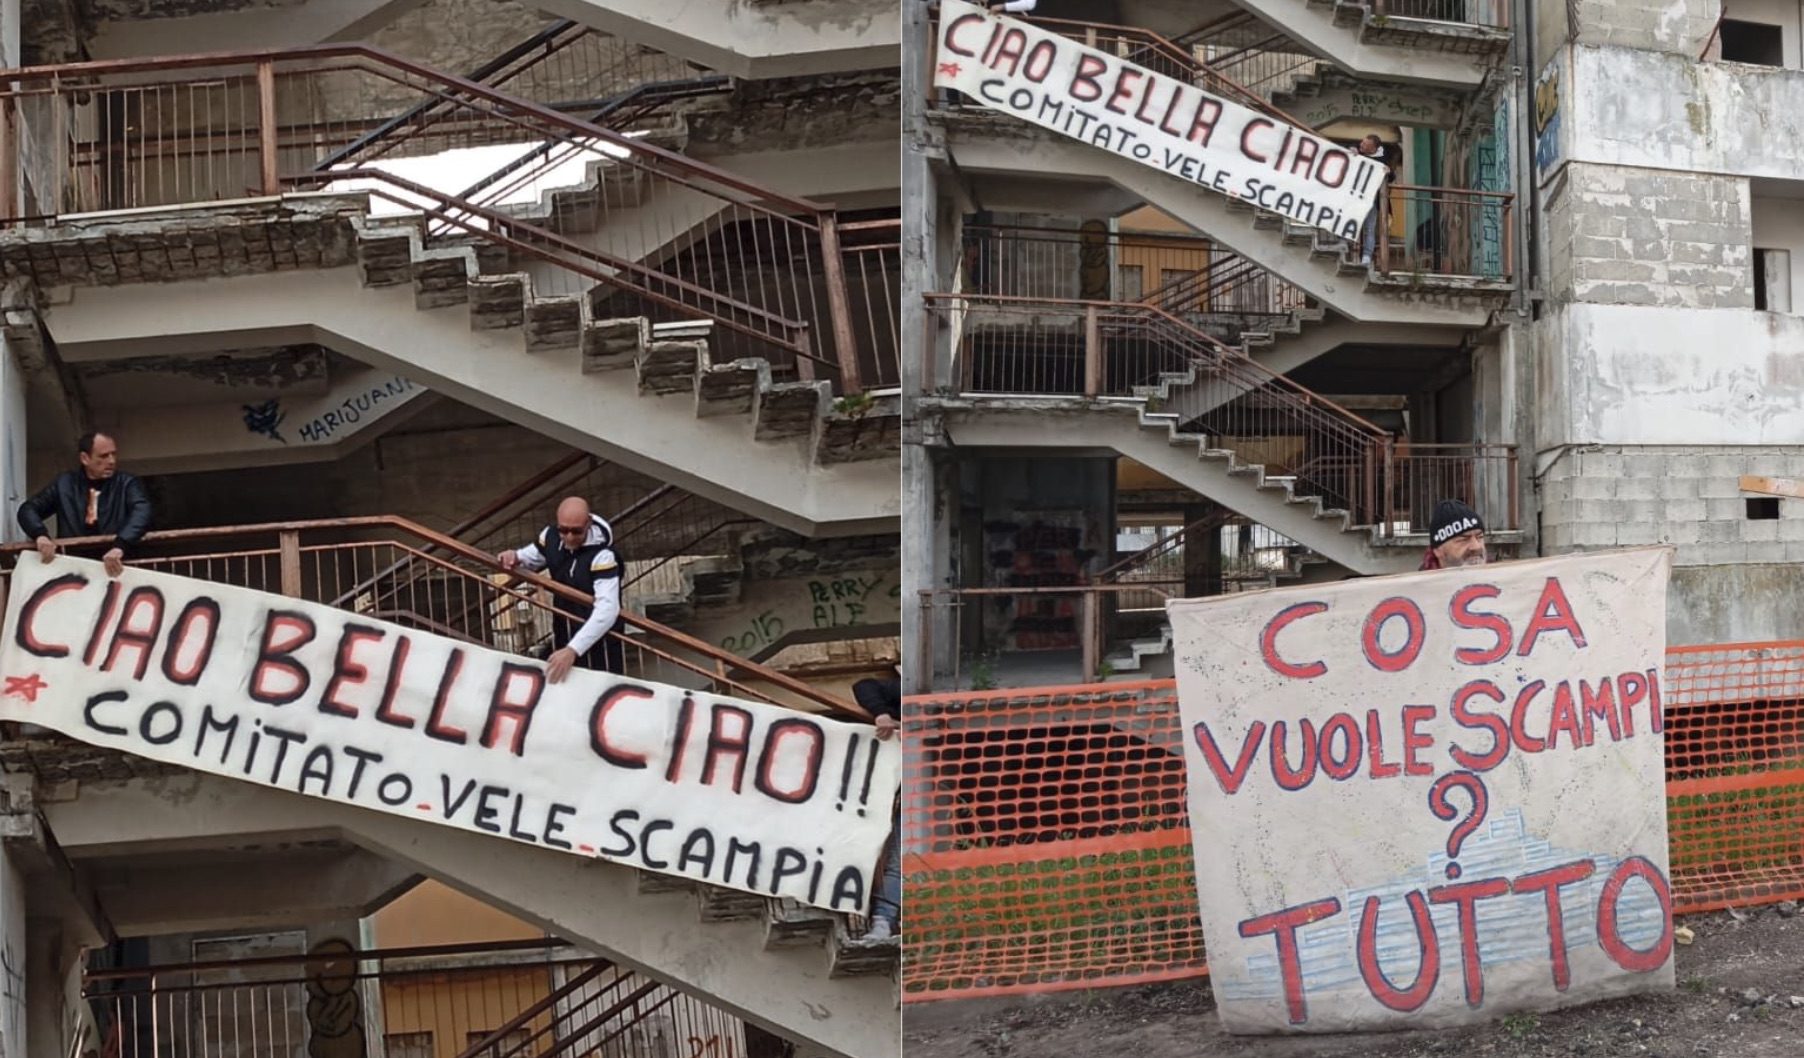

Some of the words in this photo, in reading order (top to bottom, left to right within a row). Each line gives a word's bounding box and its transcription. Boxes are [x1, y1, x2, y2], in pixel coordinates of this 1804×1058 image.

[944, 12, 1058, 84] CIAO
[1068, 52, 1223, 149] BELLA
[1162, 147, 1231, 192] VELE
[808, 576, 883, 602] PERRY
[1258, 576, 1588, 679] COSA
[15, 573, 221, 686] CIAO
[248, 609, 546, 756] BELLA
[1193, 704, 1437, 795] VUOLE
[1448, 667, 1663, 773] SCAMPI
[440, 773, 577, 850] VELE
[1427, 769, 1489, 880] ?
[1238, 855, 1674, 1025] TUTTO
